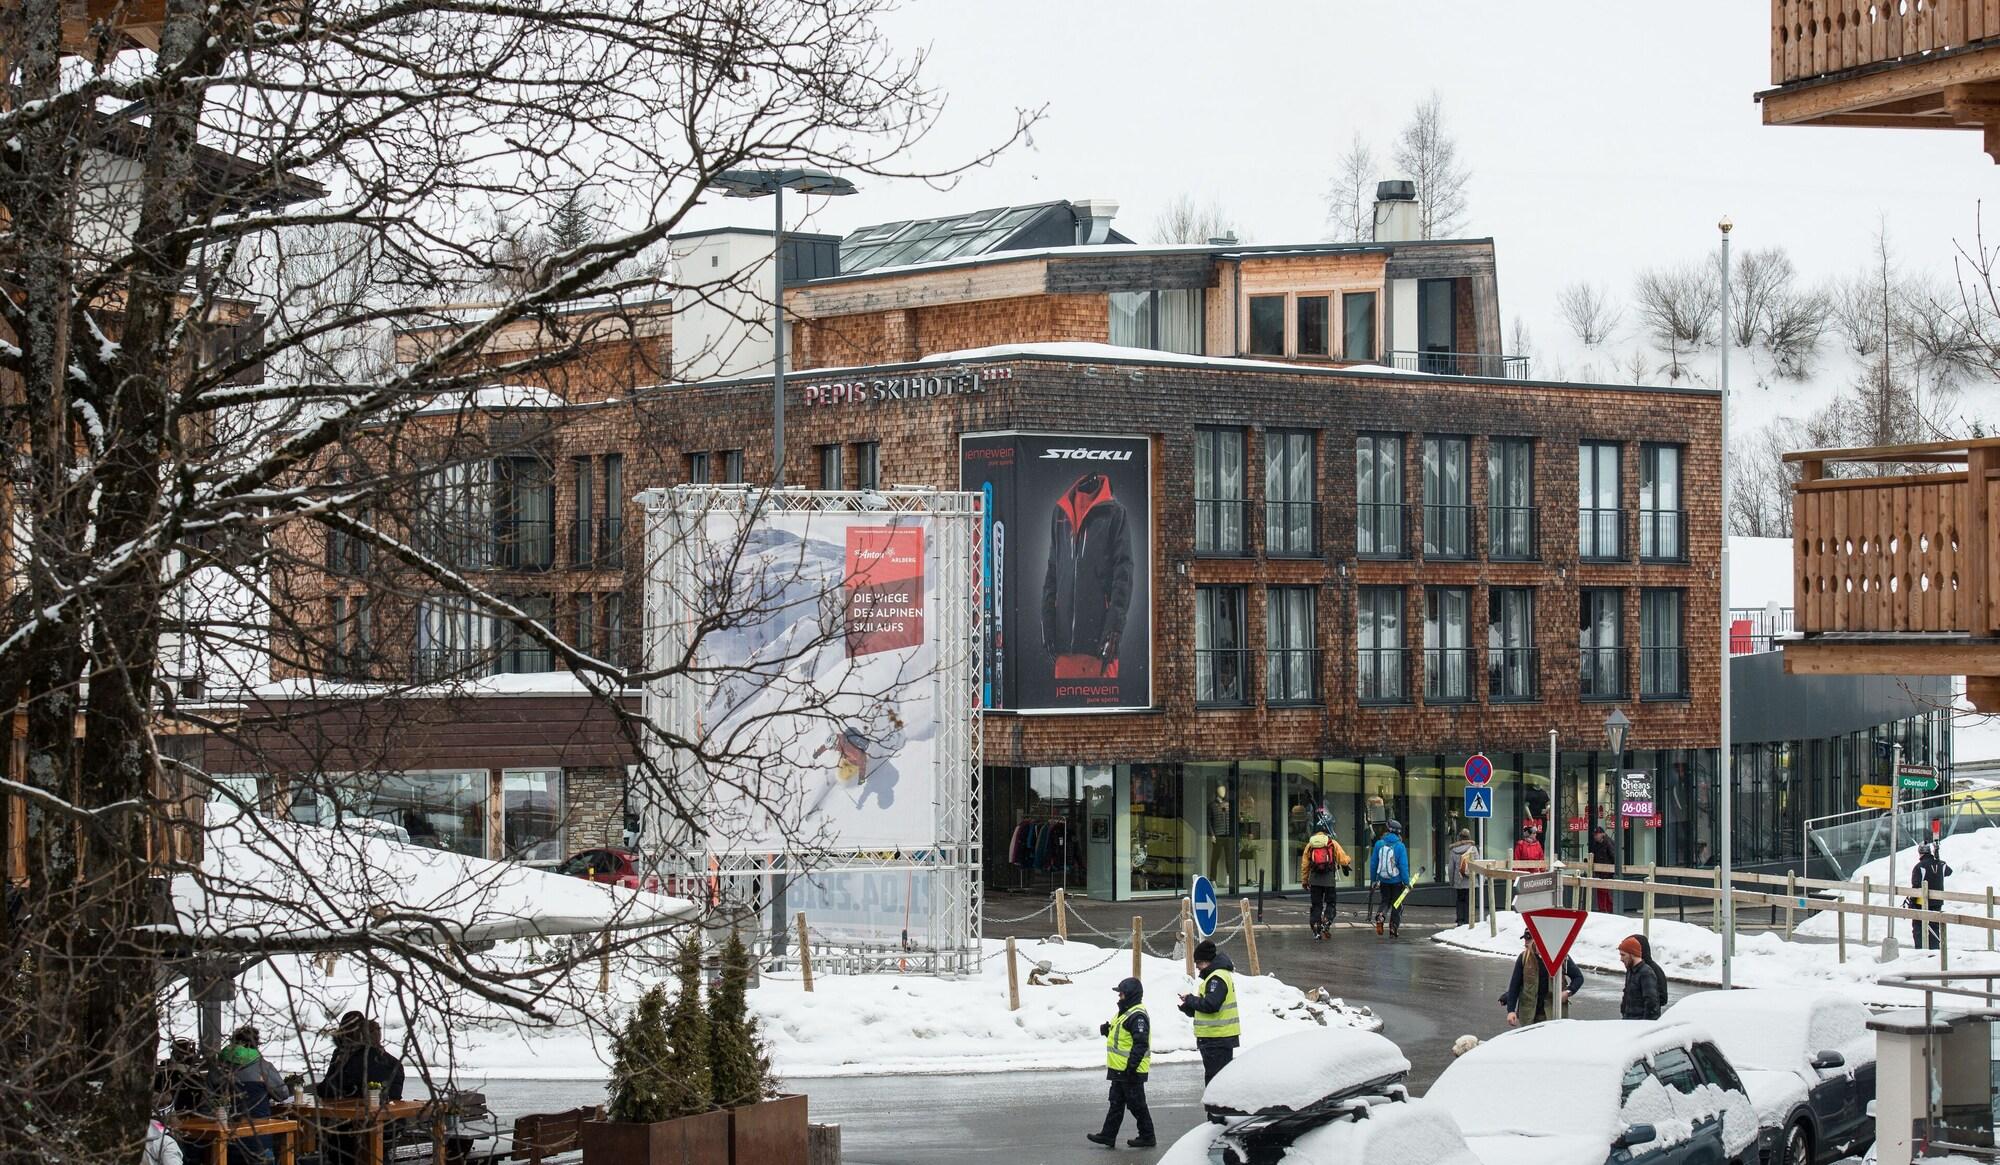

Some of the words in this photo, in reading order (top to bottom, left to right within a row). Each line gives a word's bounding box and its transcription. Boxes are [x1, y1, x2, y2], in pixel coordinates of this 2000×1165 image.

[805, 382, 866, 406] PEPIS
[872, 373, 986, 400] SKIHOTEL
[1038, 447, 1133, 461] STÖCKLI
[854, 593, 872, 603] DIE
[854, 608, 874, 617] DES
[876, 608, 923, 617] ALPINEN
[1055, 686, 1119, 697] jennewein
[1903, 778, 1929, 787] Oberdorf
[1622, 803, 1648, 813] 06-08
[1569, 822, 1589, 831] sale
[1645, 817, 1662, 827] sale
